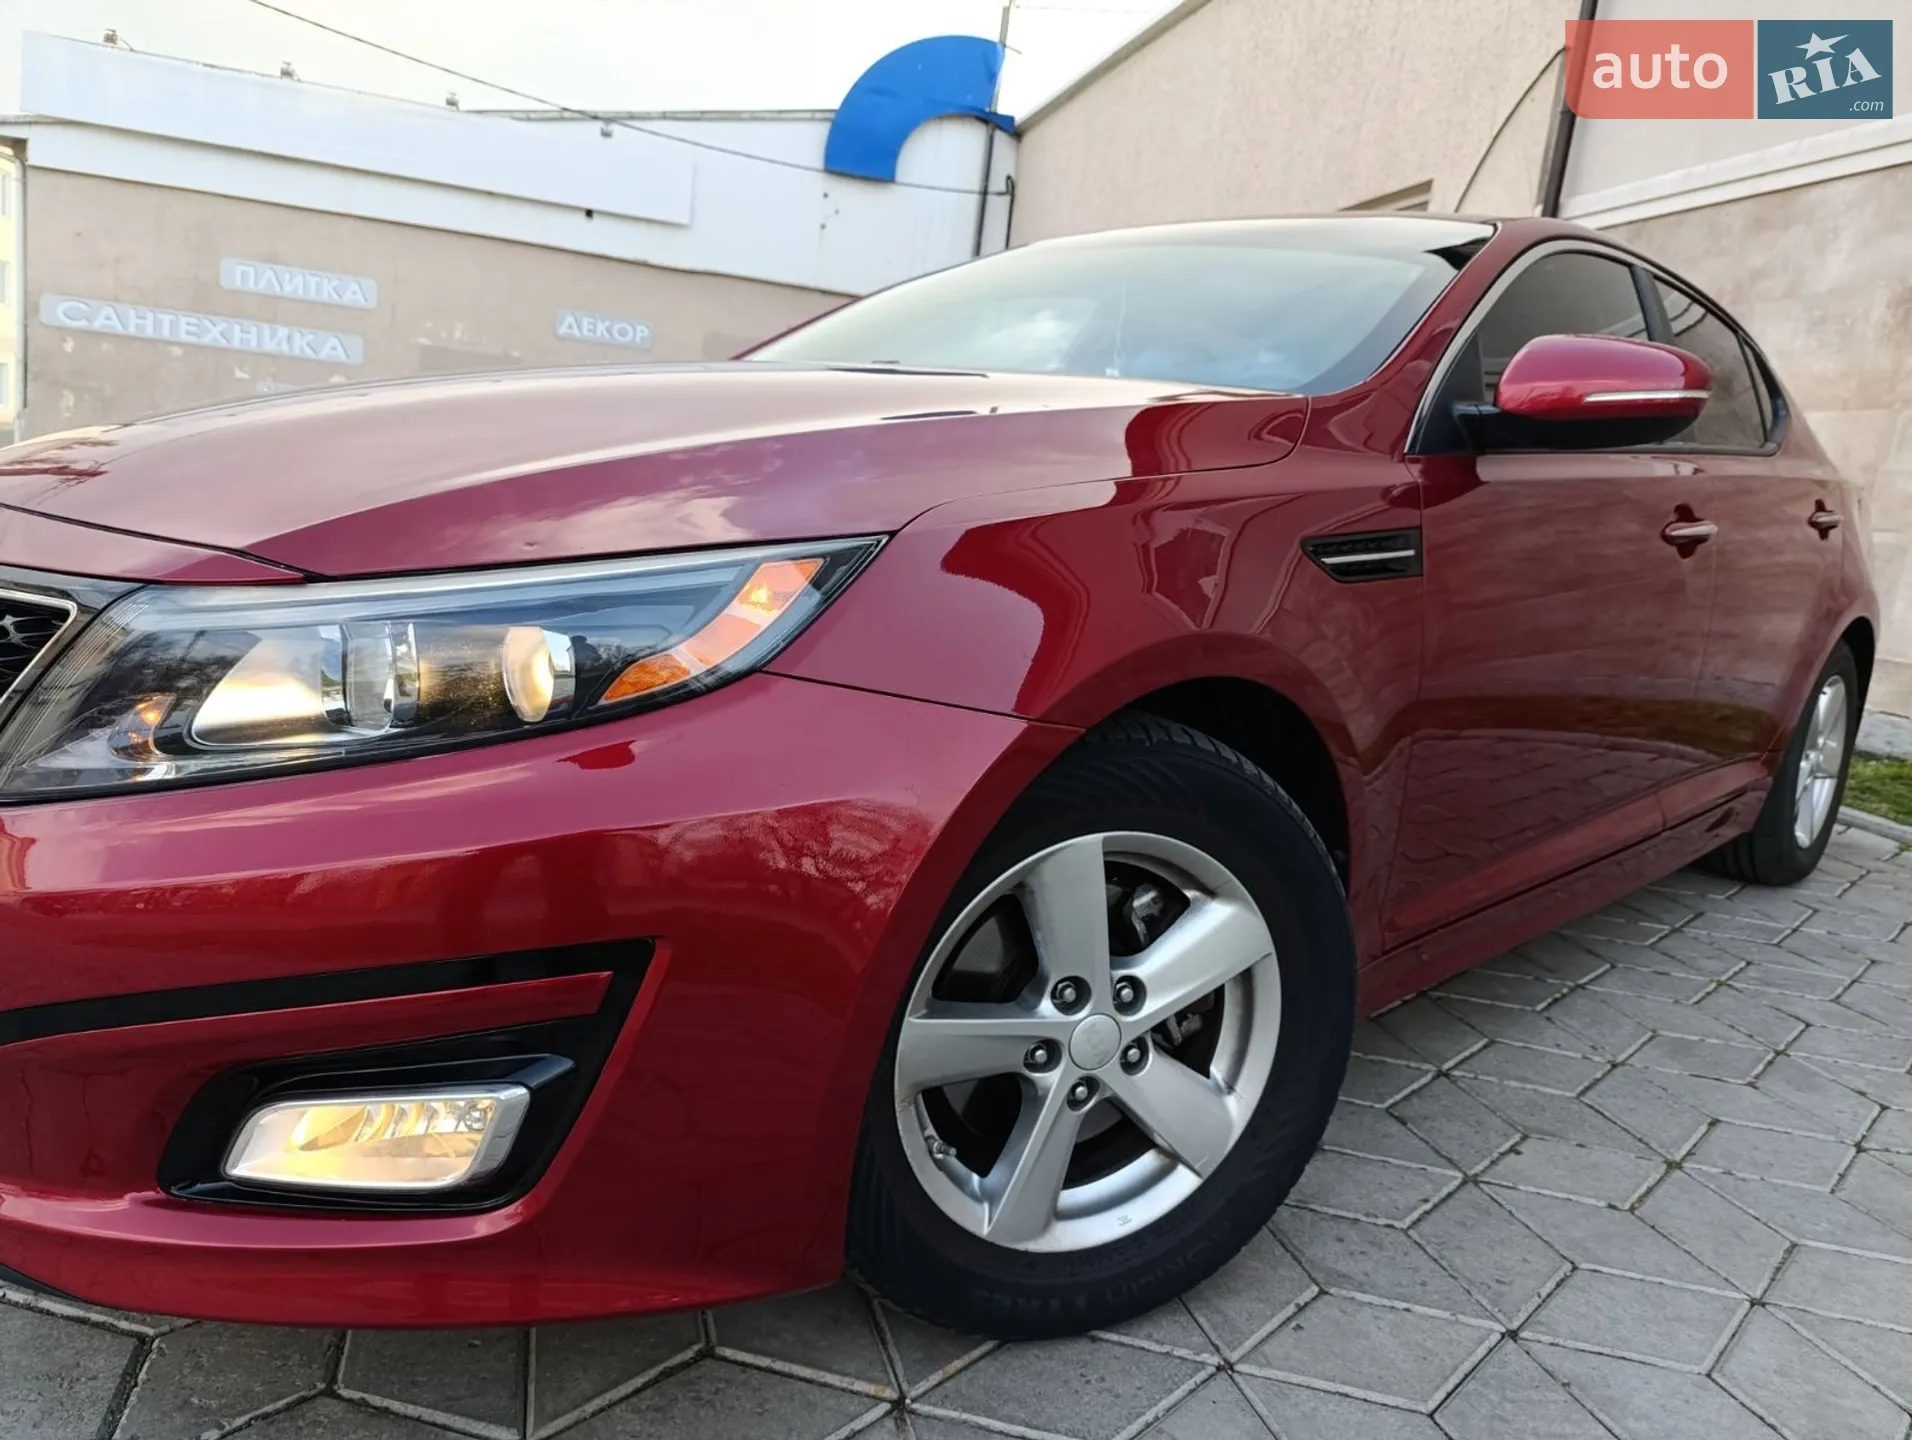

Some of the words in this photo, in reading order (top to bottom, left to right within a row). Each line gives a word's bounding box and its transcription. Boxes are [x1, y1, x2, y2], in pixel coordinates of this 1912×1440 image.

[234, 263, 368, 304] ПЛИТКА
[55, 299, 351, 362] САНТЕХНИКА
[558, 313, 650, 344] ДЕКОР
